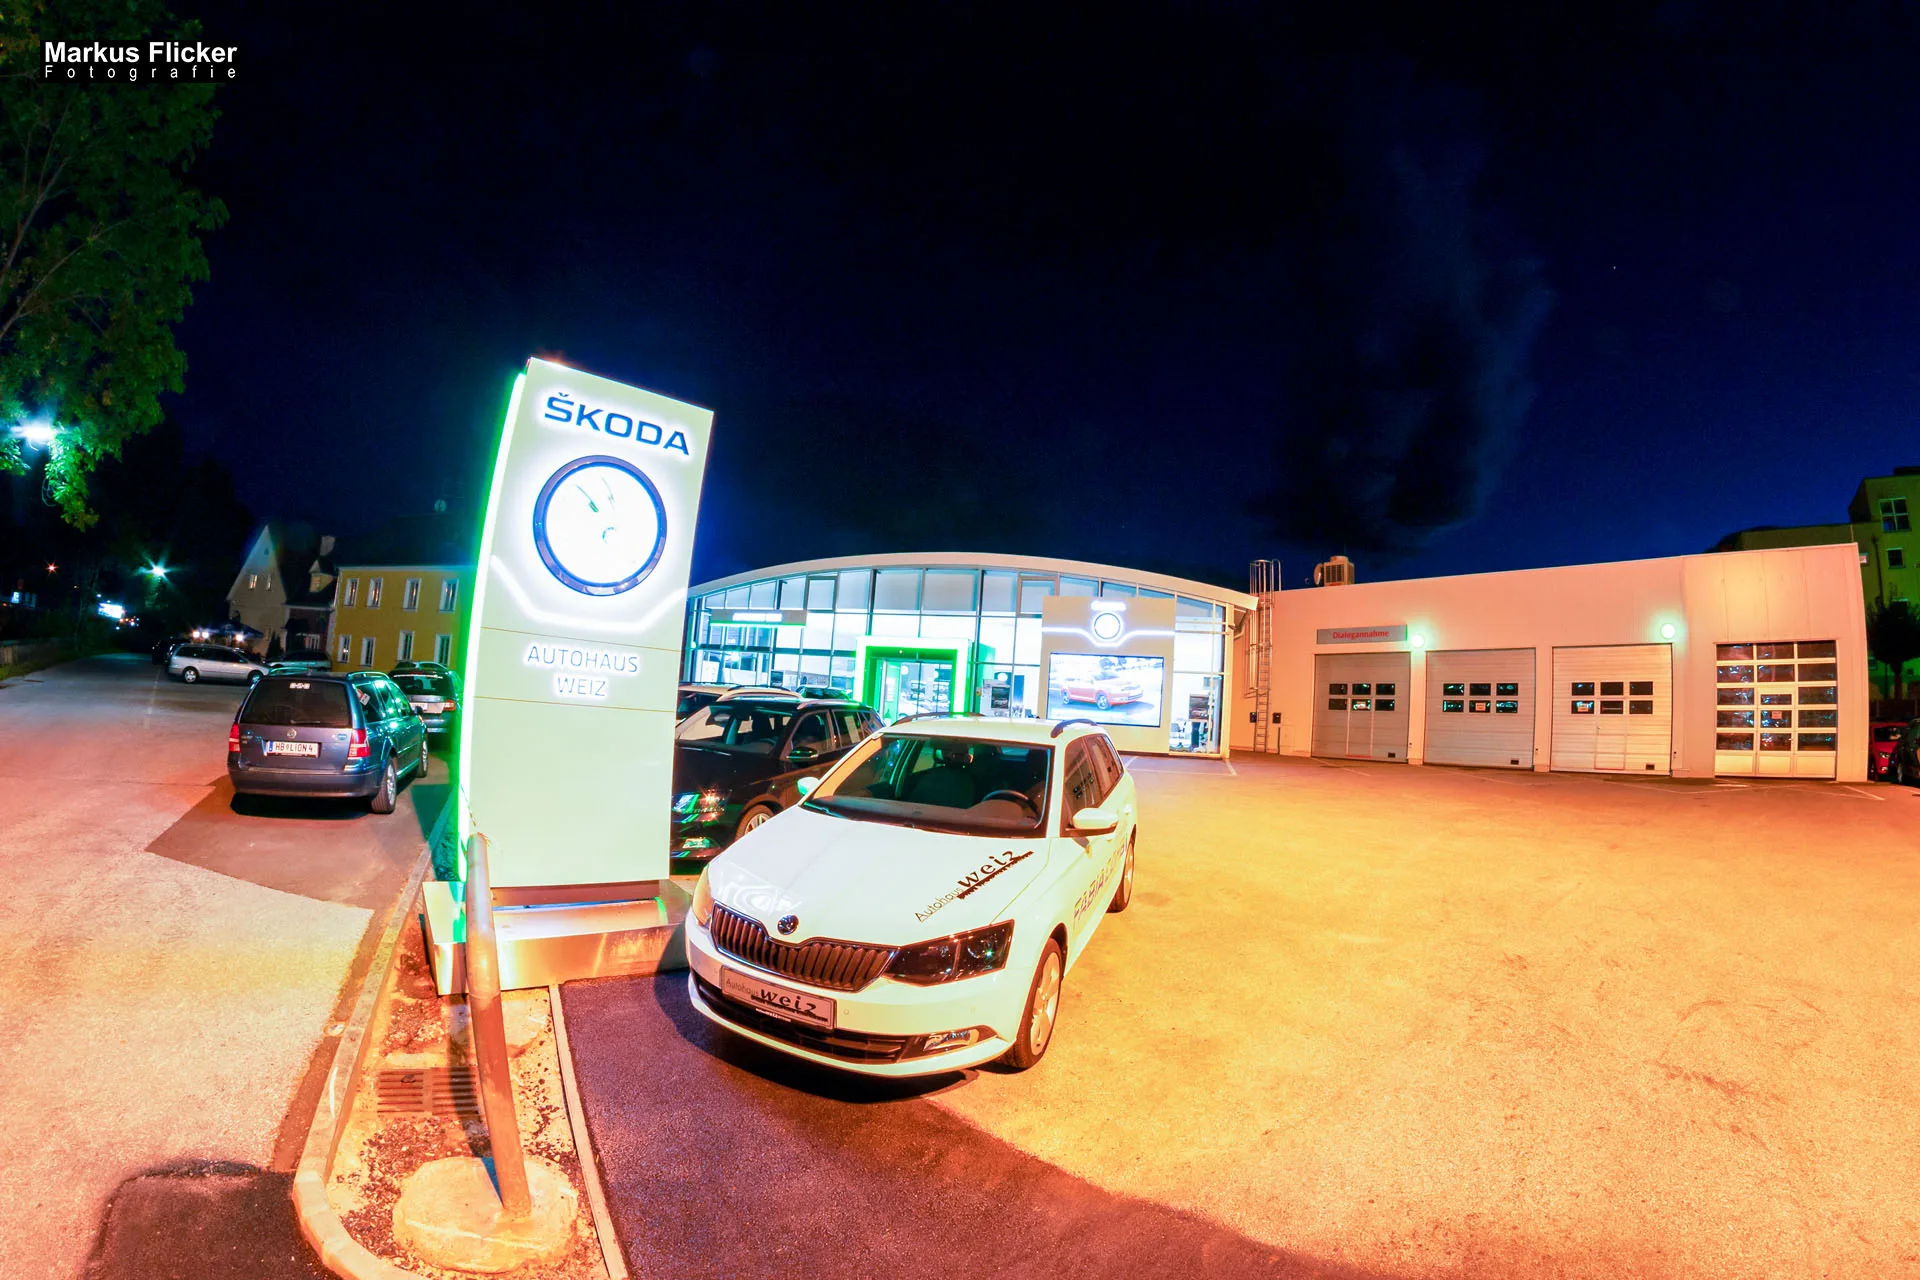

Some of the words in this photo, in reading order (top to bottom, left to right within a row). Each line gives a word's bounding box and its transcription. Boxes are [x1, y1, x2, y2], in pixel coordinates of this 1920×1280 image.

[544, 391, 690, 456] ŠKODA
[1331, 629, 1390, 641] Dialogannahme
[527, 645, 639, 673] AUTOHAUS
[557, 676, 606, 697] WEIZ
[914, 886, 965, 923] Autohaus
[956, 850, 1027, 893] weiz
[724, 977, 759, 998] Autohaus
[758, 988, 822, 1018] weiz
